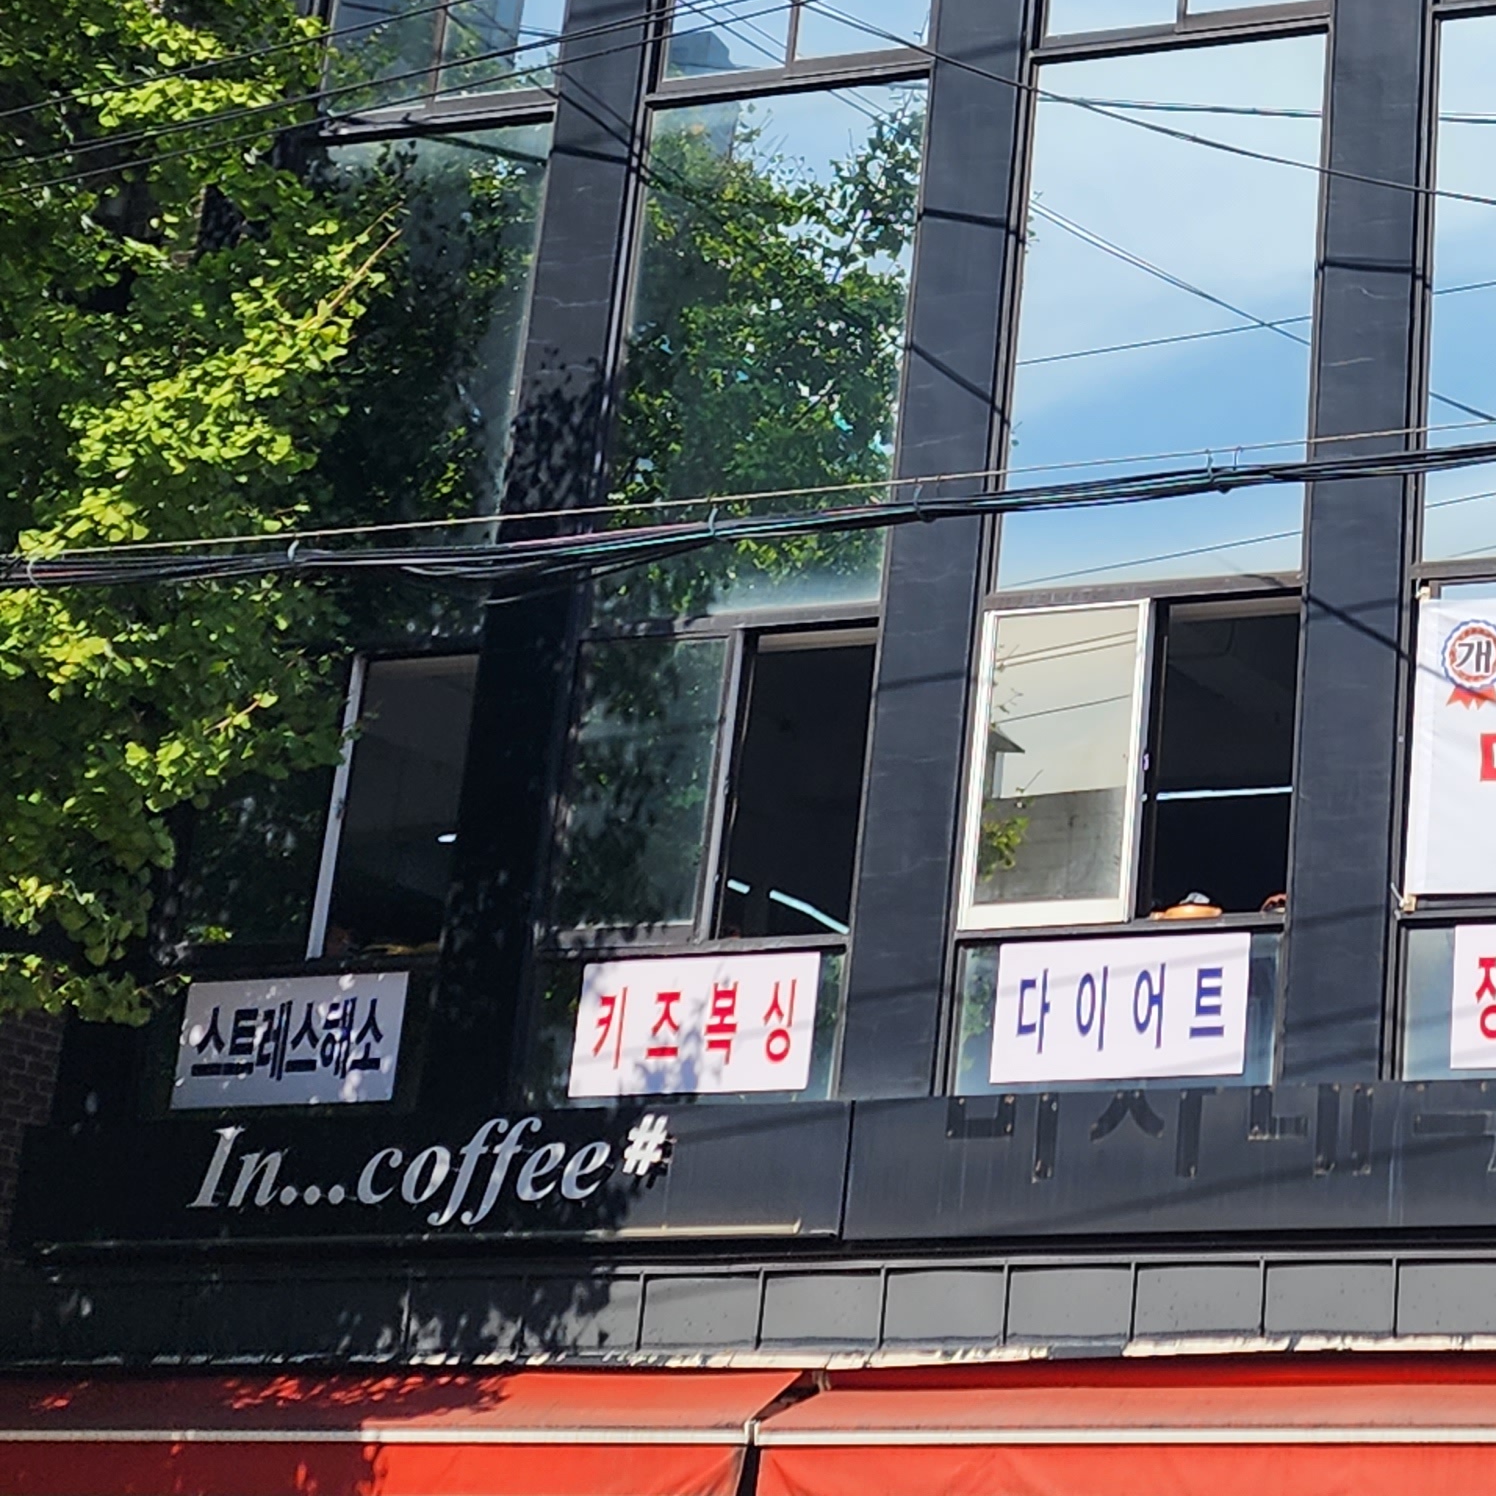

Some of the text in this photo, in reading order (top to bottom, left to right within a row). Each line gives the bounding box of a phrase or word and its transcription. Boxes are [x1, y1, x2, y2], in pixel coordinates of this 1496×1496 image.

[1456, 640, 1492, 674] 개
[191, 997, 384, 1081] 스트레스해소
[591, 978, 797, 1069] 키즈복싱
[1016, 962, 1225, 1055] 다이어트
